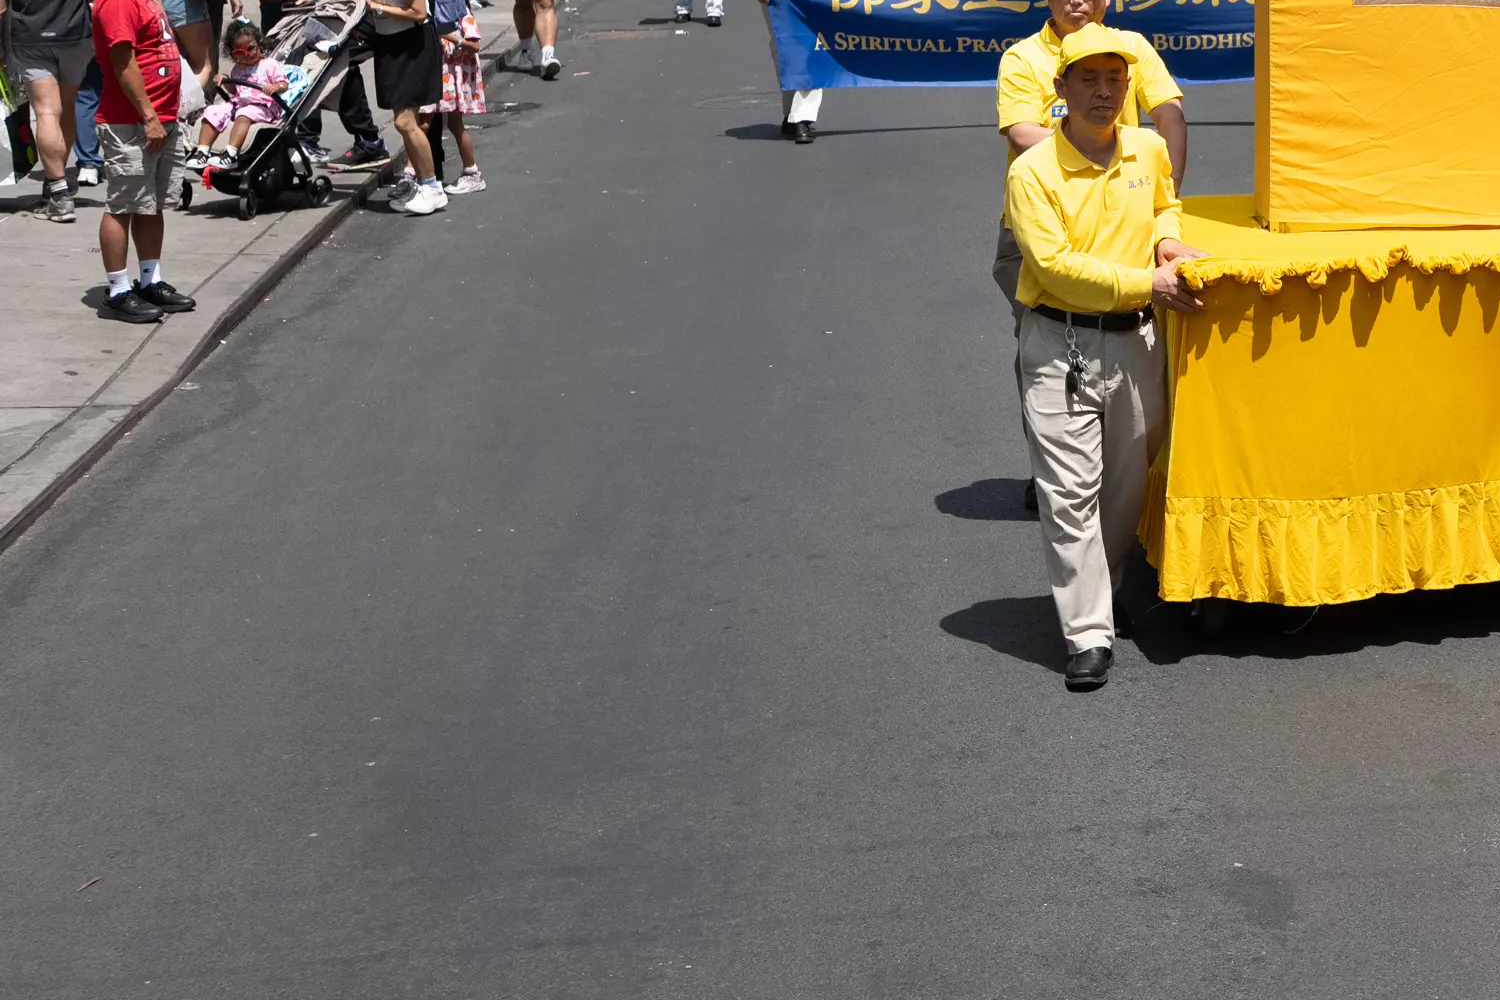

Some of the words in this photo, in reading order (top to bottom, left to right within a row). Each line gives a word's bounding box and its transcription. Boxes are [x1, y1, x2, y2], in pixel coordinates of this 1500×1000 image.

[814, 34, 829, 51] A
[834, 33, 952, 53] SPIRITUAL
[1152, 32, 1254, 51] BUDDHIS
